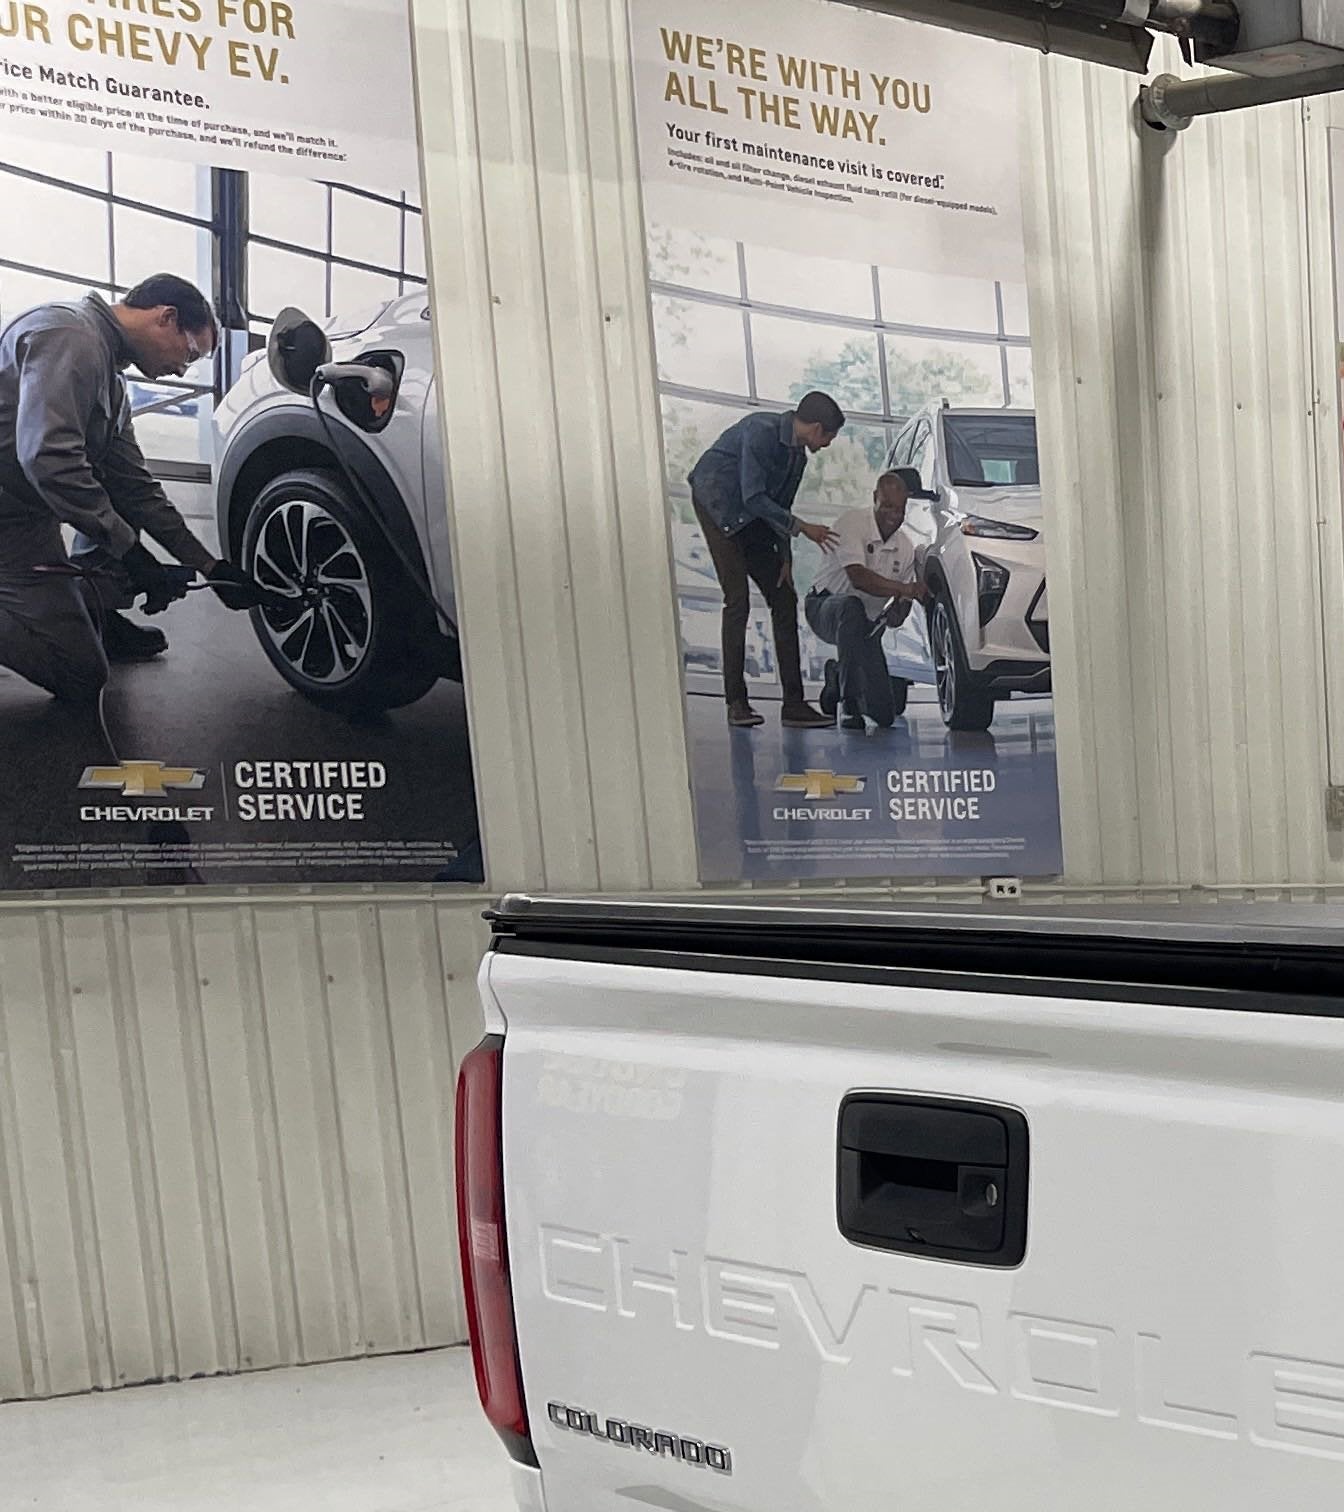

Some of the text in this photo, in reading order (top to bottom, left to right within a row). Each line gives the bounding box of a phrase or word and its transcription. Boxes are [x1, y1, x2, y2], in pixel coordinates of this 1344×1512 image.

[217, 0, 296, 40] FOR
[67, 13, 213, 71] CHEVY
[228, 39, 290, 84] EV.
[0, 58, 211, 109] ice Match Guarantee.
[660, 27, 932, 114] WE'RE WITH YOU
[39, 108, 73, 121] within
[90, 117, 114, 130] days
[664, 71, 887, 146] ALL THE WAY.
[665, 122, 701, 143] Your
[704, 130, 738, 152] first
[742, 142, 835, 171] maintenance
[837, 159, 869, 178] visit
[871, 163, 884, 180] is
[234, 760, 388, 790] CERTIFIED
[886, 769, 996, 793] CERTIFIED
[79, 805, 215, 823] CHEVROLET
[237, 793, 365, 822] SERVICE
[772, 806, 873, 822] CHEVROLET
[888, 797, 981, 821] SERVICE
[546, 1399, 733, 1475] COLORADO
